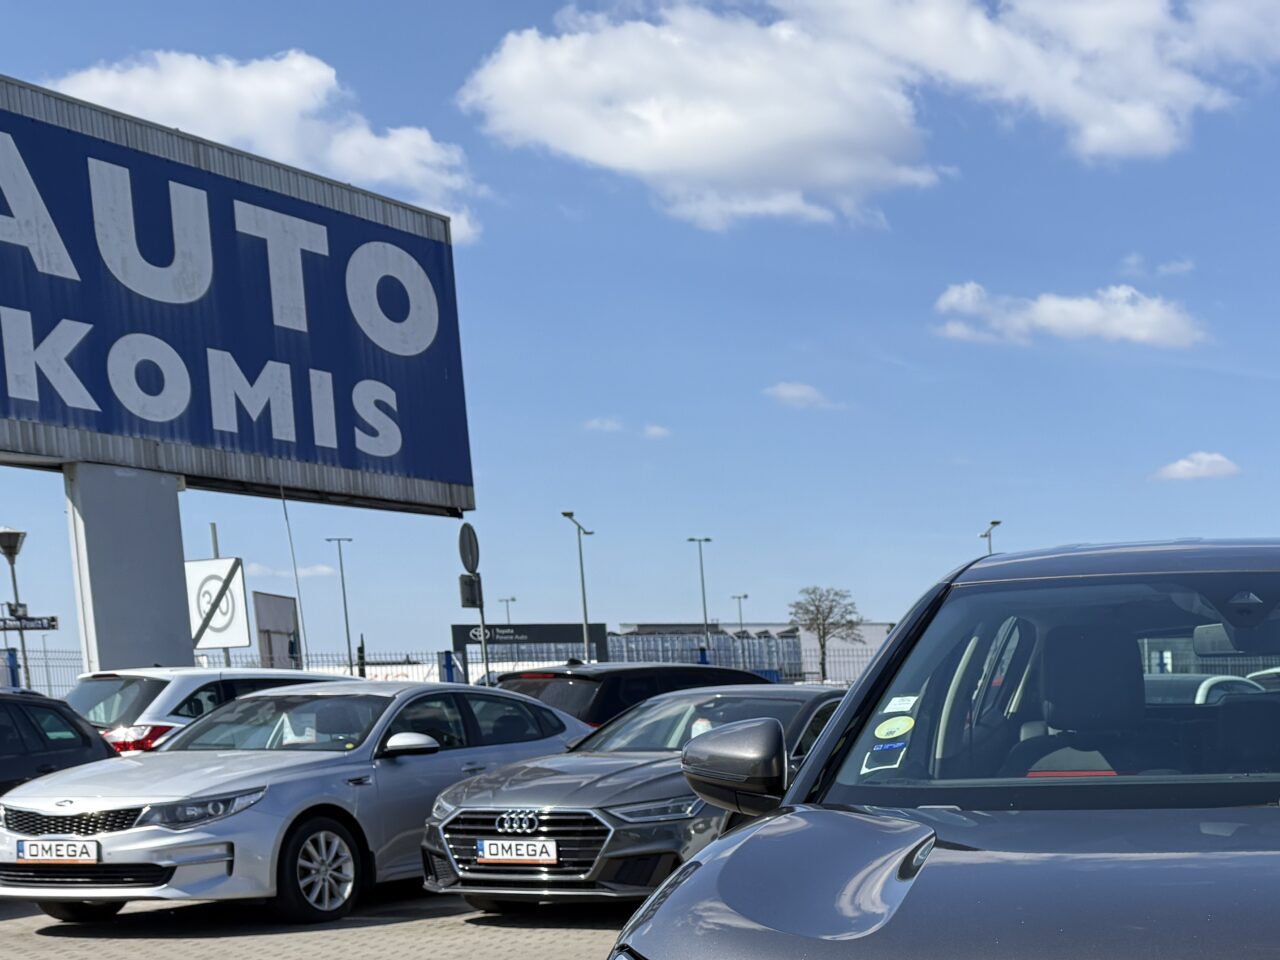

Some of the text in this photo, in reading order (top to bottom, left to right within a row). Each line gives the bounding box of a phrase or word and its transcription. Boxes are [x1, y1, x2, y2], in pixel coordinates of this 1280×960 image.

[0, 306, 403, 458] KOMIS
[29, 843, 91, 857] OMEGA
[488, 843, 550, 857] OMEGA
